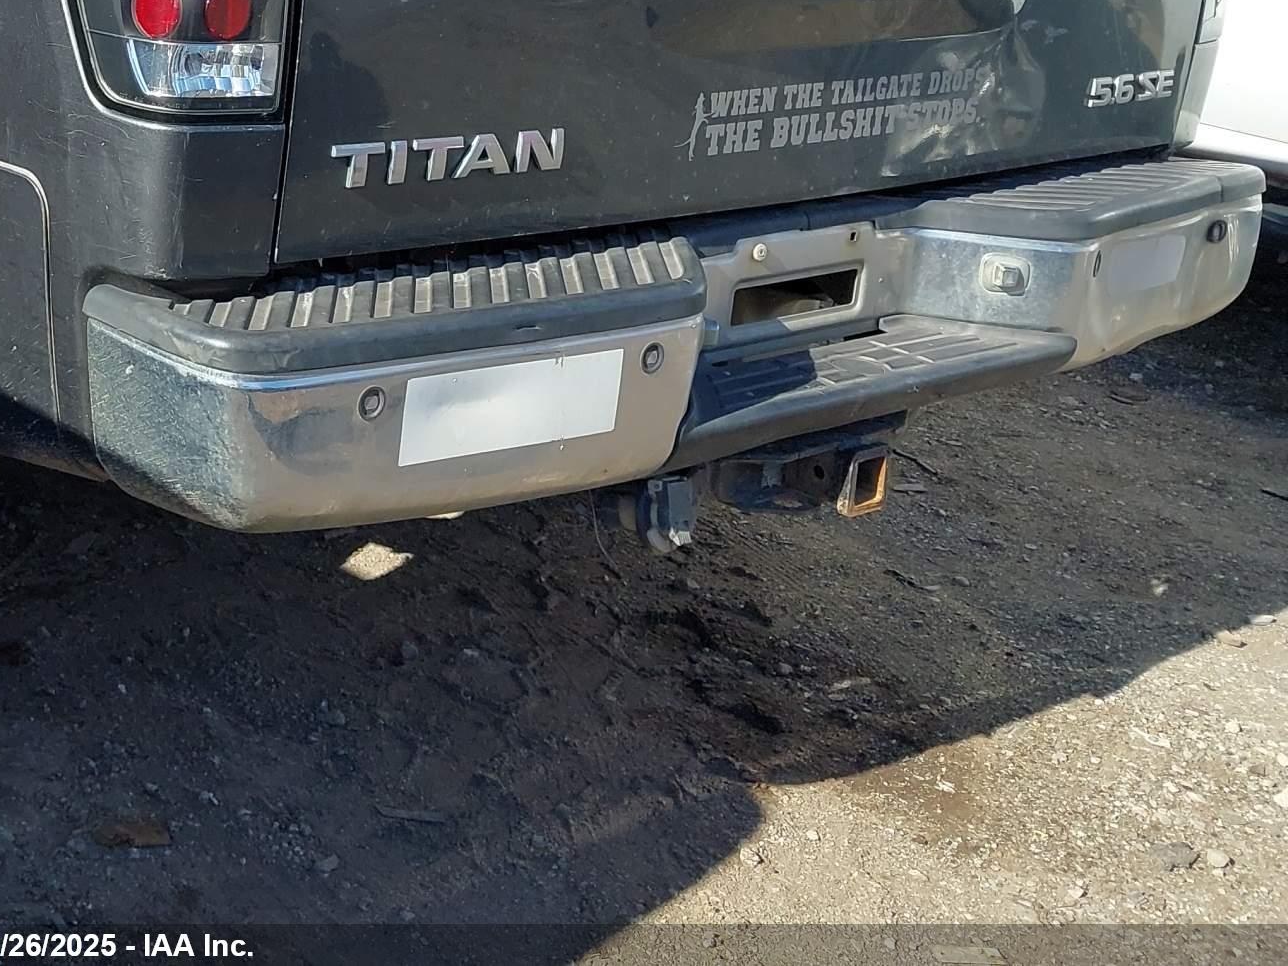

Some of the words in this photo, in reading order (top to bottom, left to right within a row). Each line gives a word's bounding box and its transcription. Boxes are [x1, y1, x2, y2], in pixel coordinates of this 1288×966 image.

[711, 87, 777, 118] WHEN
[783, 83, 824, 110] THE
[831, 73, 921, 105] TAILGATE
[1135, 69, 1175, 102] SE
[706, 120, 762, 156] THE
[770, 104, 905, 149] BULLSHIT
[331, 128, 565, 189] TITAN
